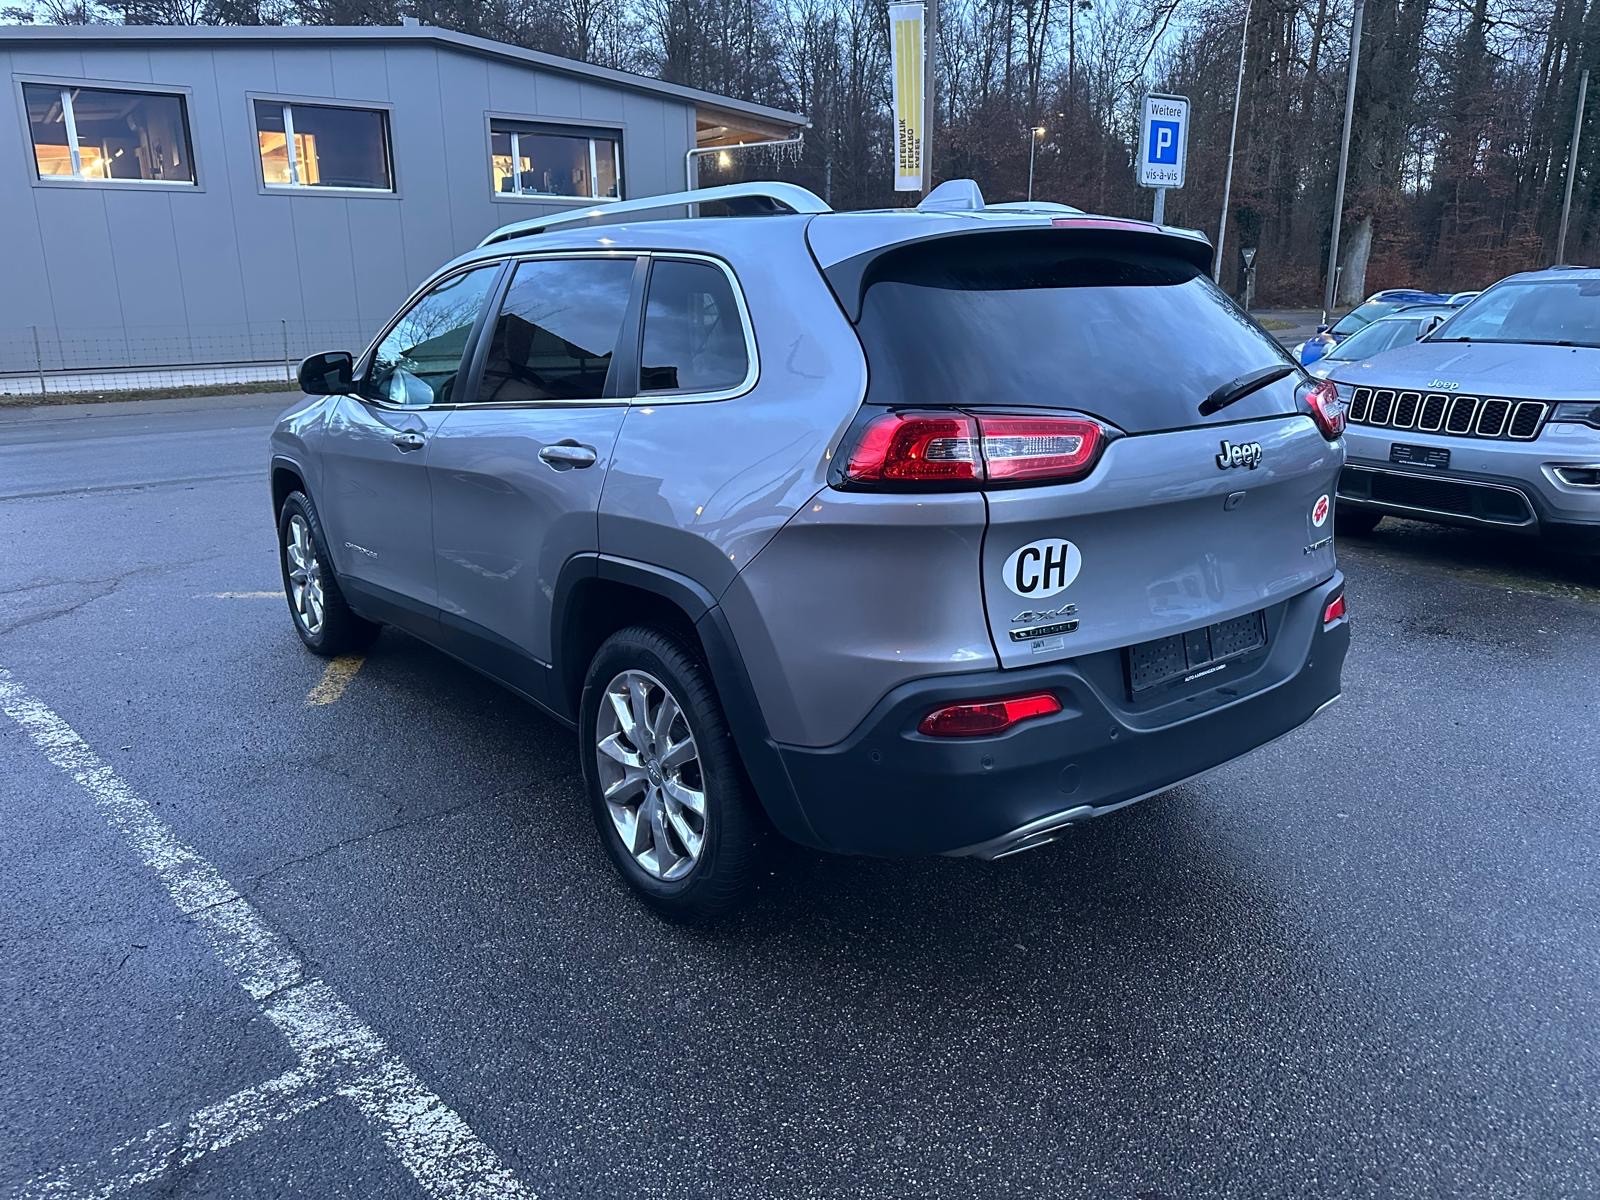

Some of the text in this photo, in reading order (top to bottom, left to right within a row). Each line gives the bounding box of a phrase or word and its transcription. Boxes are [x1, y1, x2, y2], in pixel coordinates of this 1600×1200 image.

[1151, 103, 1182, 117] Weitere
[1156, 127, 1172, 159] P
[1145, 168, 1178, 181] vis-à-vis
[1428, 379, 1459, 391] Jeep
[1216, 440, 1262, 470] Jeep
[1016, 544, 1068, 594] CH
